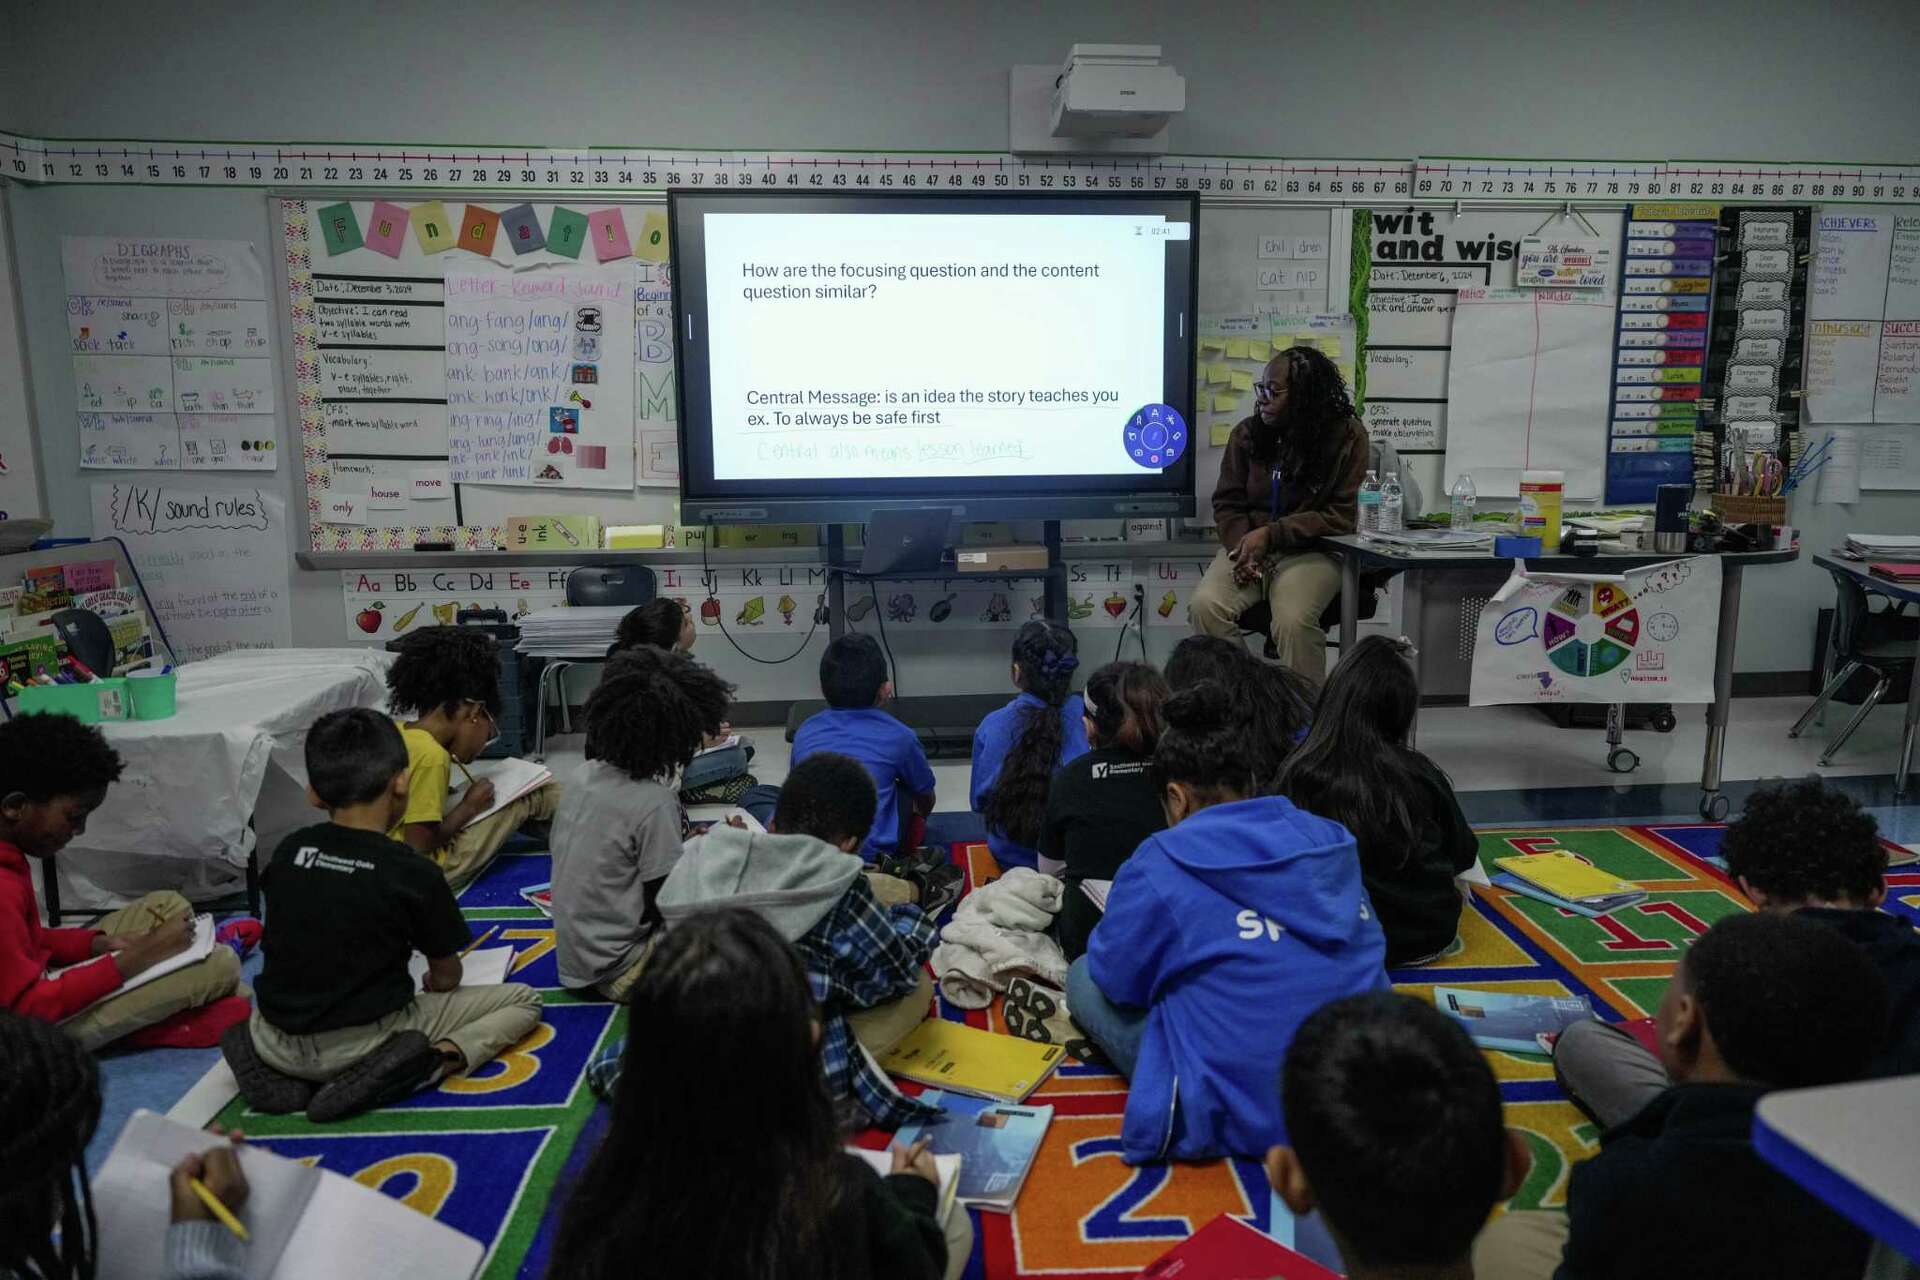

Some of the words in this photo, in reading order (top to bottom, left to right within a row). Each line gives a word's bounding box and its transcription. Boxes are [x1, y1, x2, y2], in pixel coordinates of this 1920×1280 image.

[12, 159, 26, 173] 10
[42, 163, 54, 176] 11
[69, 164, 82, 176] 12
[96, 164, 108, 176] 13
[121, 164, 134, 176] 14
[147, 165, 159, 177] 15
[172, 166, 185, 177] 16
[199, 166, 210, 178] 17
[224, 167, 236, 178] 18
[250, 167, 261, 179] 19
[274, 168, 288, 179] 20
[300, 168, 312, 179] 21
[324, 168, 338, 180] 22
[349, 168, 362, 180] 23
[374, 168, 388, 180] 24
[398, 168, 412, 180] 25
[424, 169, 438, 180] 26
[449, 170, 461, 181] 27
[1648, 183, 1660, 194] 80
[1670, 183, 1680, 194] 81
[1691, 183, 1703, 194] 82
[1712, 183, 1723, 194] 83
[1732, 184, 1744, 194] 84
[1752, 184, 1764, 195] 85
[1772, 184, 1784, 195] 86
[1792, 184, 1804, 195] 87
[1812, 185, 1824, 195] 88
[1832, 185, 1844, 196] 89
[1852, 186, 1864, 196] 90
[1874, 186, 1884, 197] 91
[1893, 186, 1904, 198] 92
[1372, 206, 1434, 236] wit
[1376, 235, 1444, 261] and
[743, 263, 778, 278] How
[783, 266, 808, 278] are
[811, 263, 836, 278] the
[840, 263, 906, 281] focusing
[910, 264, 976, 281] question
[981, 263, 1009, 278] and
[1013, 263, 1036, 278] the
[1041, 264, 1099, 278] content
[744, 283, 811, 301] question
[816, 283, 878, 299] similar?
[747, 390, 803, 405] Central
[809, 389, 880, 408] Message:
[885, 390, 898, 404] is
[902, 392, 920, 404] an
[925, 390, 956, 403] idea
[960, 389, 984, 403] the
[989, 390, 1026, 406] story
[1029, 389, 1089, 403] teaches
[1093, 390, 1119, 405] you
[748, 414, 769, 426] ex.
[773, 411, 791, 426] To
[795, 411, 849, 428] always
[853, 410, 872, 425] be
[876, 410, 907, 425] safe
[912, 410, 941, 424] first
[372, 487, 401, 499] house
[416, 480, 441, 488] move
[165, 495, 210, 521] sound
[216, 496, 257, 519] rules
[333, 502, 353, 517] only
[358, 575, 380, 592] Aa
[395, 574, 417, 592] Bb
[433, 573, 455, 591] Cc
[470, 573, 493, 592] Dd
[509, 572, 531, 590] Ee
[743, 568, 763, 587] Kk
[1071, 564, 1087, 582] Ss
[1103, 564, 1121, 582] Tt
[1159, 561, 1177, 580] Uu
